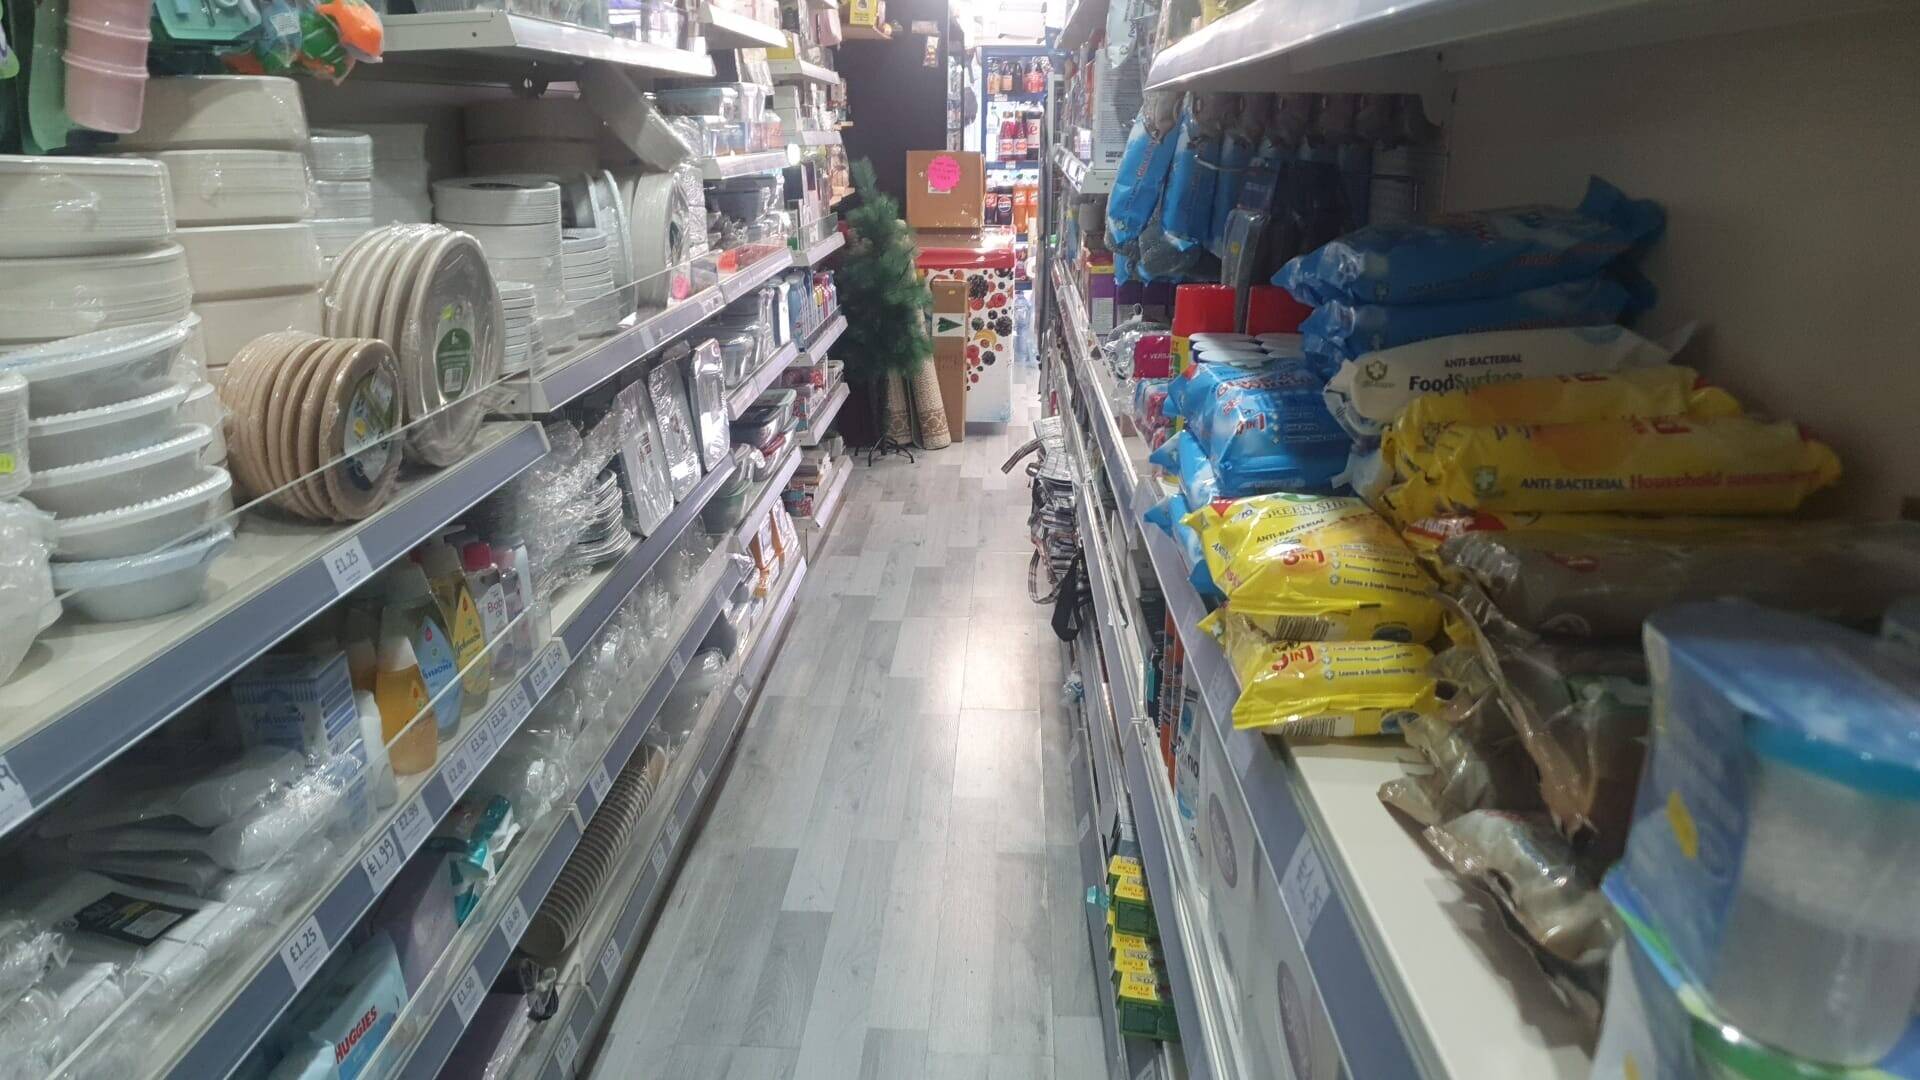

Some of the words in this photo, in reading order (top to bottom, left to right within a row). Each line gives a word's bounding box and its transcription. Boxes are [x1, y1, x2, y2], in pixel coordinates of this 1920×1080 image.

[1445, 355, 1522, 368] ANTI-BACTERIAL
[1520, 478, 1624, 490] ANTI-BACTERIAL
[1256, 518, 1325, 544] ANTI-BACTERIAL
[335, 548, 358, 575] £1.25
[398, 801, 420, 831] £2.99
[366, 838, 394, 878] £1.99
[289, 926, 318, 963] £1.25
[334, 1004, 378, 1065] HUGGIES
